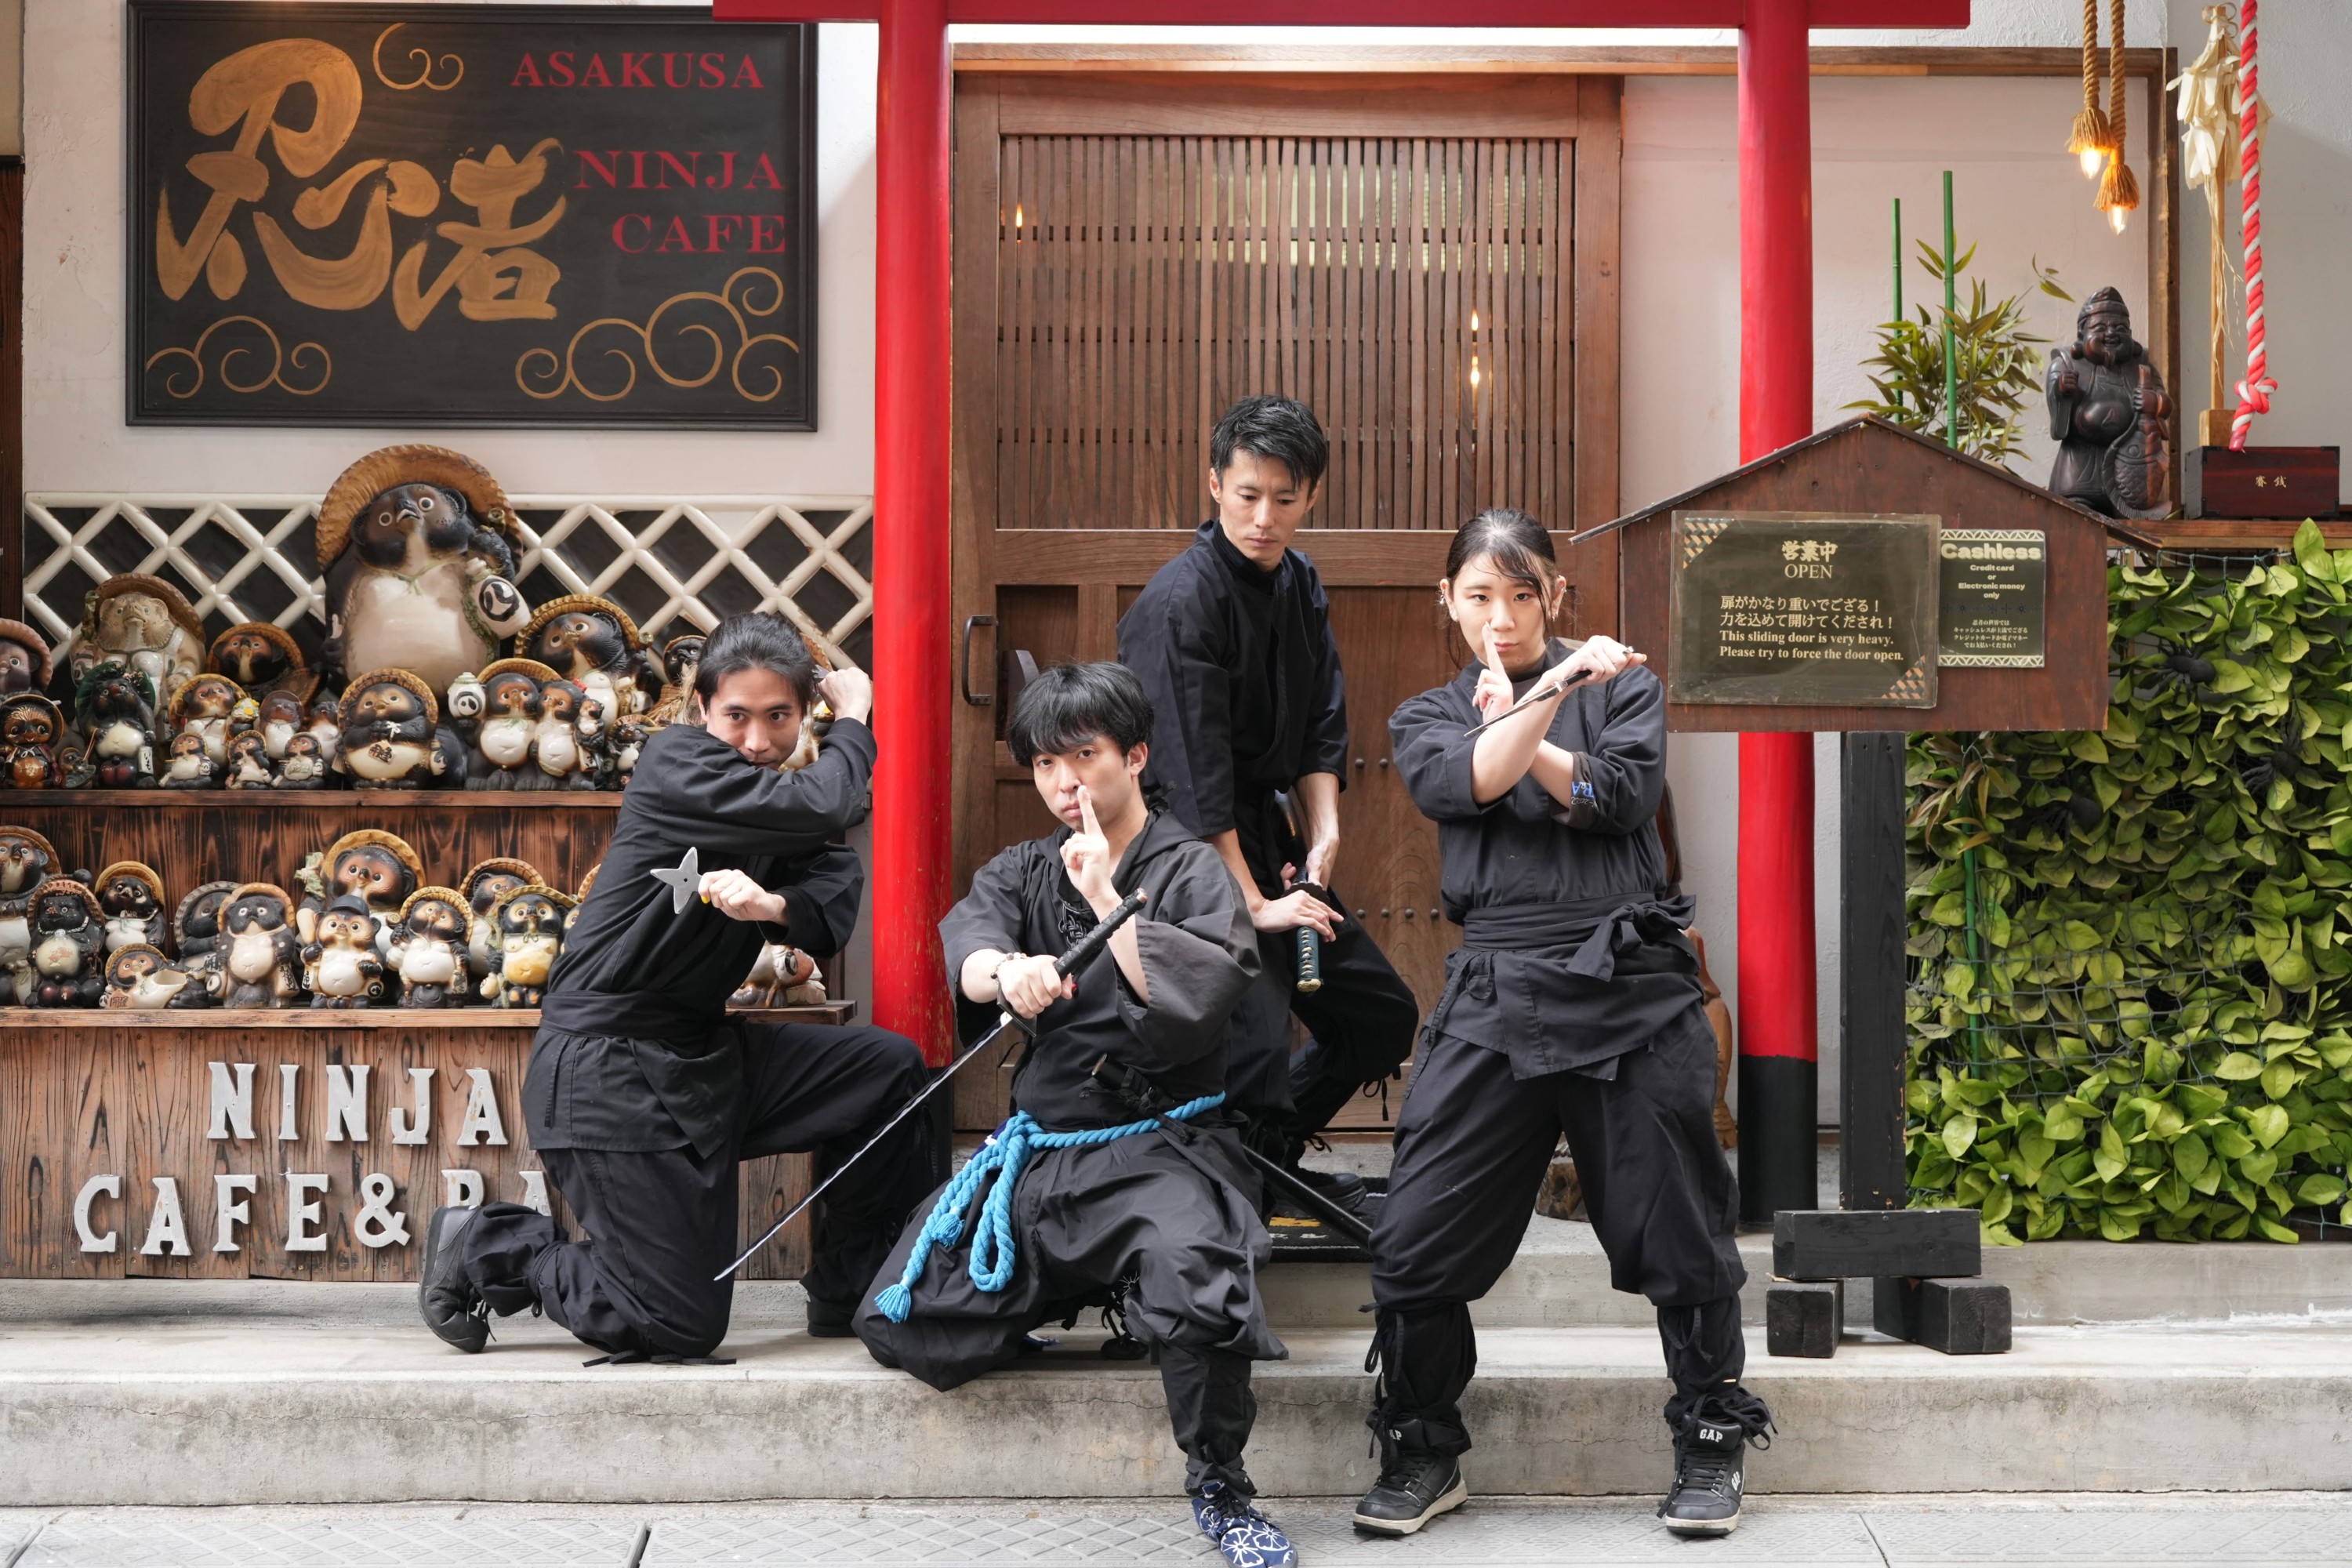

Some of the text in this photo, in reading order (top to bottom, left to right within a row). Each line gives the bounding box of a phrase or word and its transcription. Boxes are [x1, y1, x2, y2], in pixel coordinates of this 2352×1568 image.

[511, 52, 764, 88] ASAKUSA
[572, 150, 785, 189] NINJA
[612, 213, 786, 253] CAFE
[1781, 539, 1838, 562] 営業中
[1940, 543, 2042, 560] Cashless
[1784, 564, 1833, 579] OPEN
[1984, 591, 2000, 600] only
[1719, 630, 1894, 647] This sliding door is very heavy.
[1719, 646, 1904, 662] Please try to force the door open.
[207, 1062, 509, 1146] NINJA
[1388, 1428, 1403, 1441] AP
[1699, 1428, 1723, 1443] GAP
